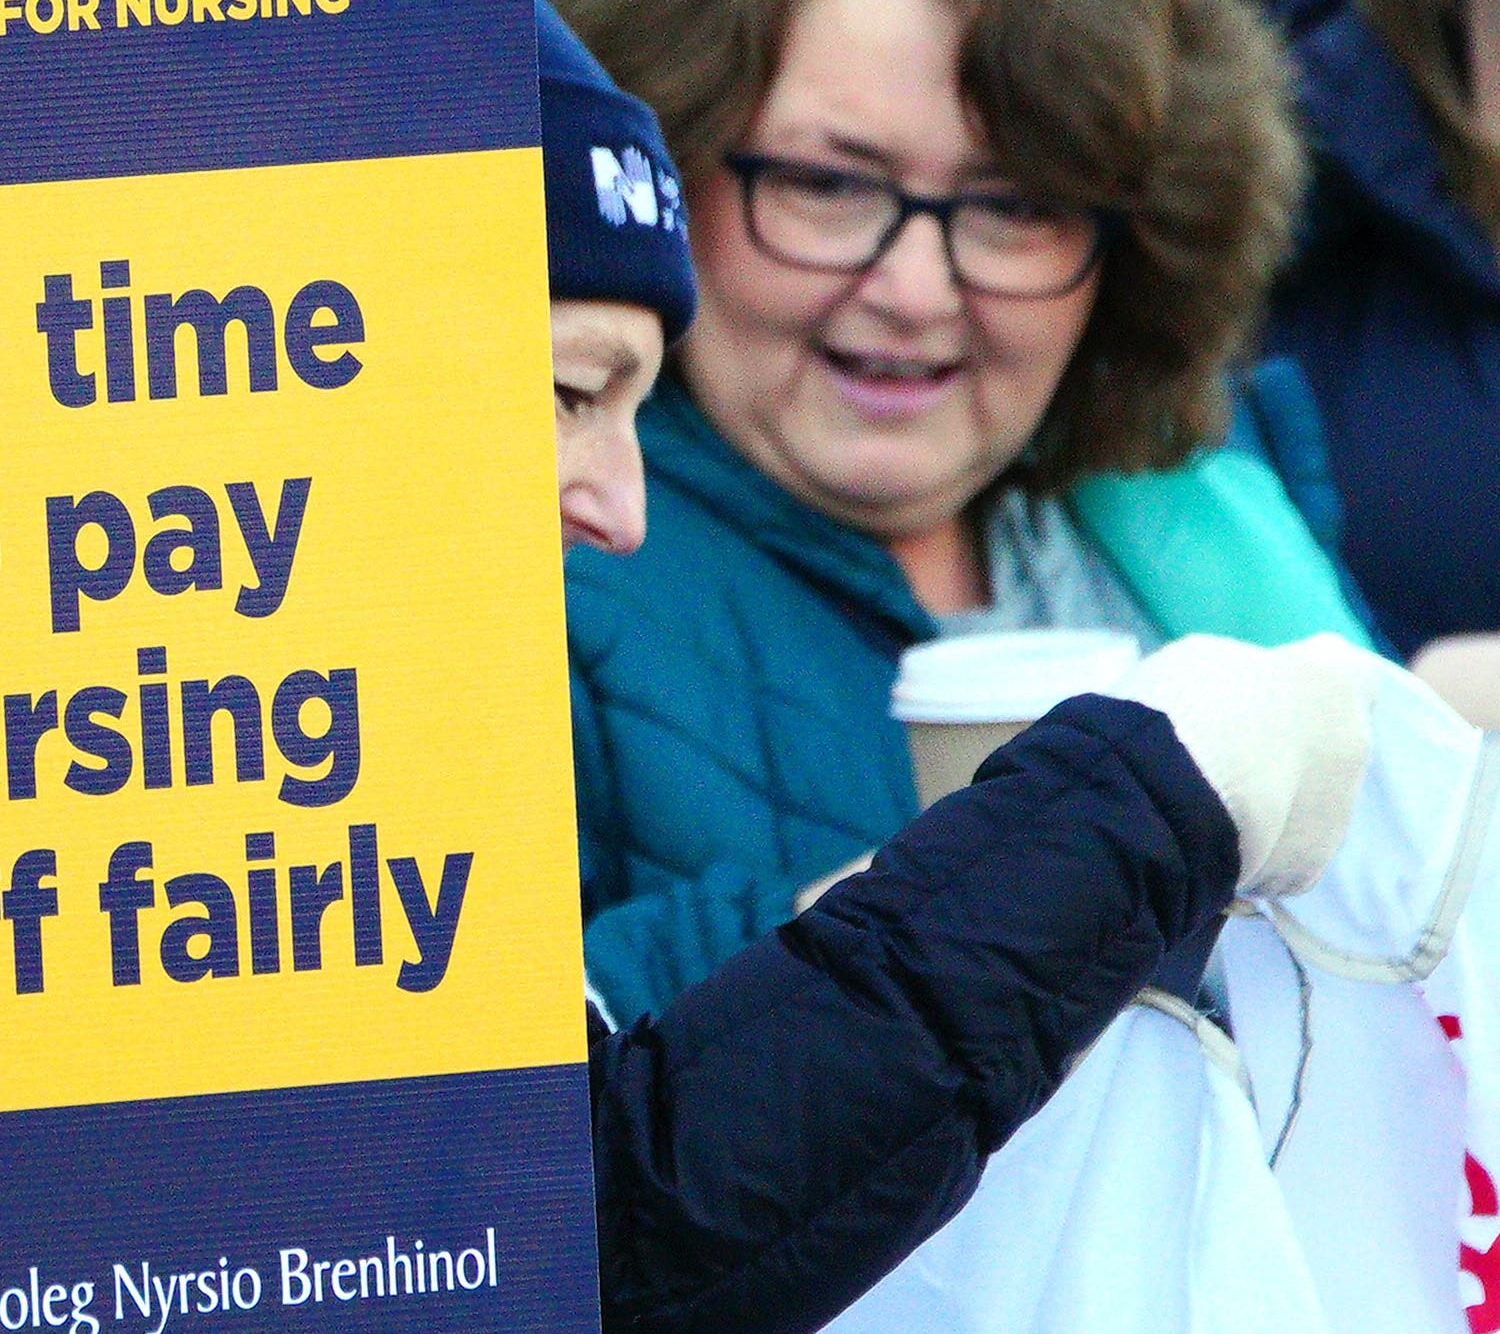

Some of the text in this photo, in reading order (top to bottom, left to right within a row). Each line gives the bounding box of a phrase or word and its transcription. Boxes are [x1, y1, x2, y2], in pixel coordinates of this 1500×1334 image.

[36, 260, 364, 408] time
[46, 478, 312, 633] pay
[99, 824, 474, 992] fairly
[280, 1228, 496, 1304] Brenhinol
